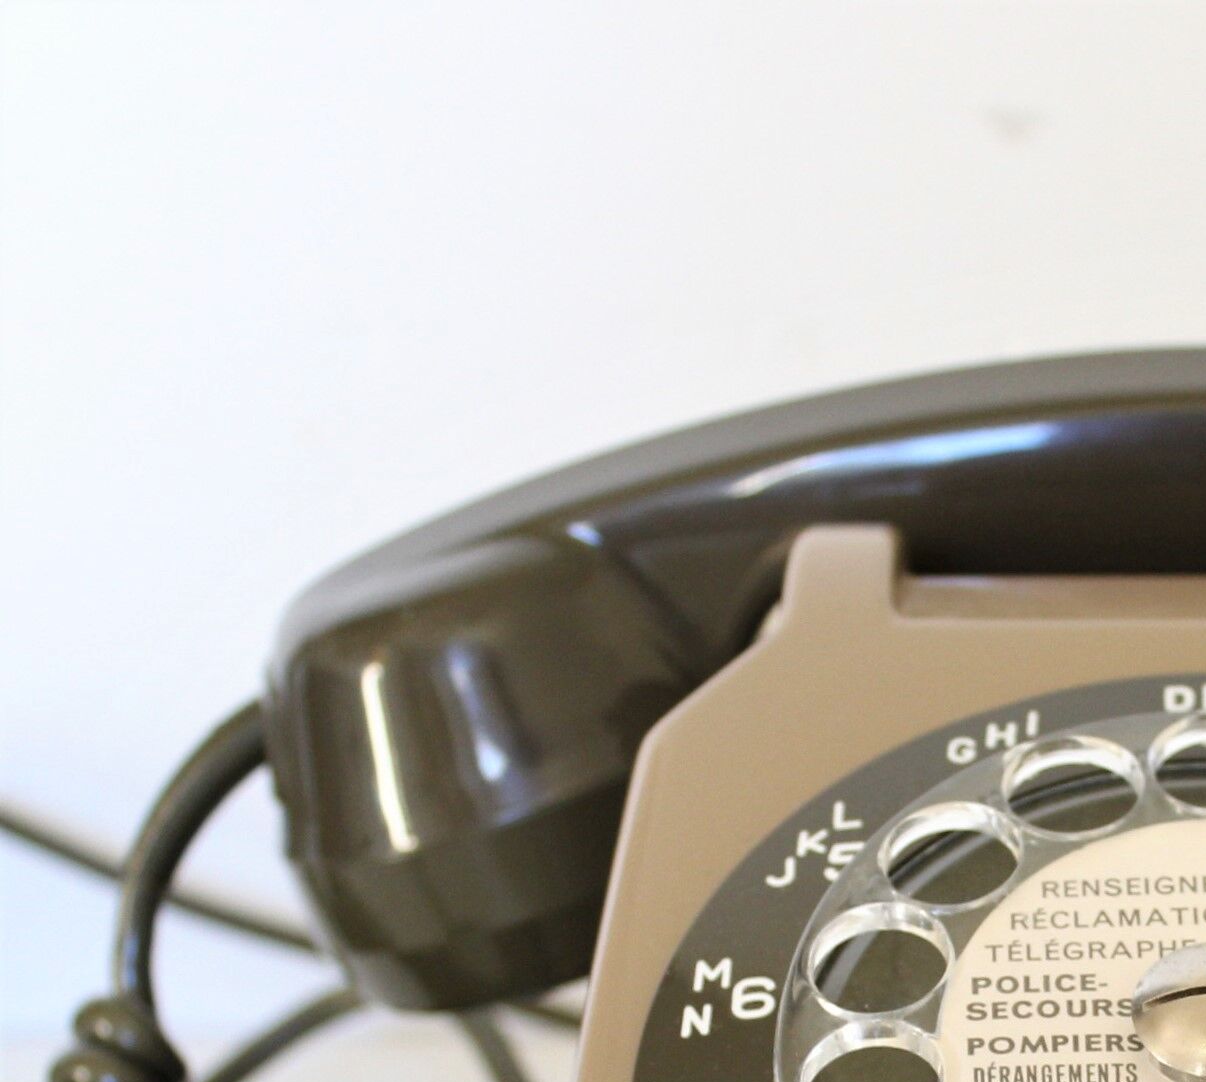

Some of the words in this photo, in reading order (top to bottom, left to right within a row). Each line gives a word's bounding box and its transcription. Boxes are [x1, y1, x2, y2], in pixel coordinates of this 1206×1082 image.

[971, 973, 1108, 996] POLICE-
[730, 977, 777, 1021] 6
[966, 998, 1133, 1021] SECOURS
[967, 1033, 1144, 1056] POMPIERS
